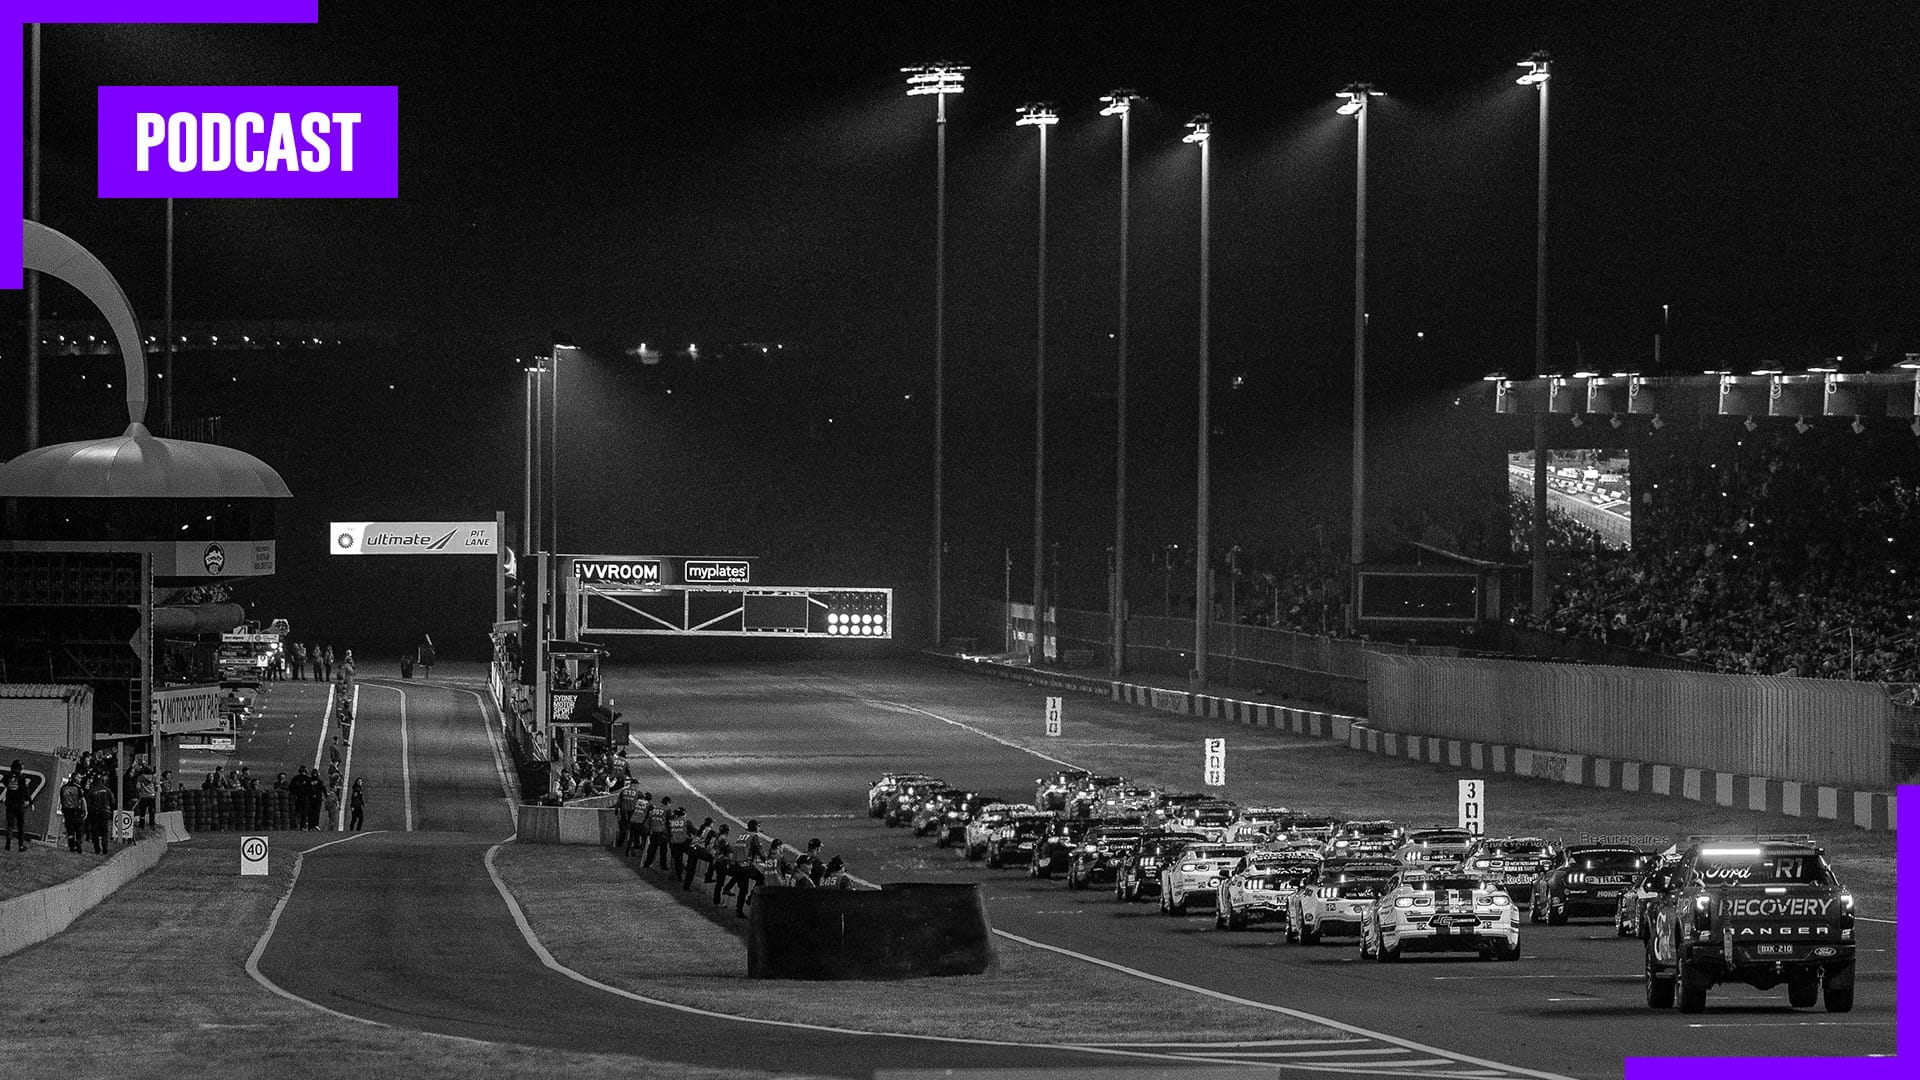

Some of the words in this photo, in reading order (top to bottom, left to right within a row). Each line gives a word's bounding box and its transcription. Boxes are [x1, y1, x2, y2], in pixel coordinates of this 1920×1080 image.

[367, 533, 431, 546] ultimate
[465, 538, 490, 546] LANE
[582, 563, 658, 579] VVROOM
[688, 563, 747, 580] myplates
[553, 694, 578, 702] SYDNEY
[1580, 832, 1669, 846] Beaurepaires
[247, 844, 263, 856] 40
[1706, 863, 1752, 879] Ford
[1775, 858, 1803, 878] R1
[1719, 898, 1834, 916] RECOVERY
